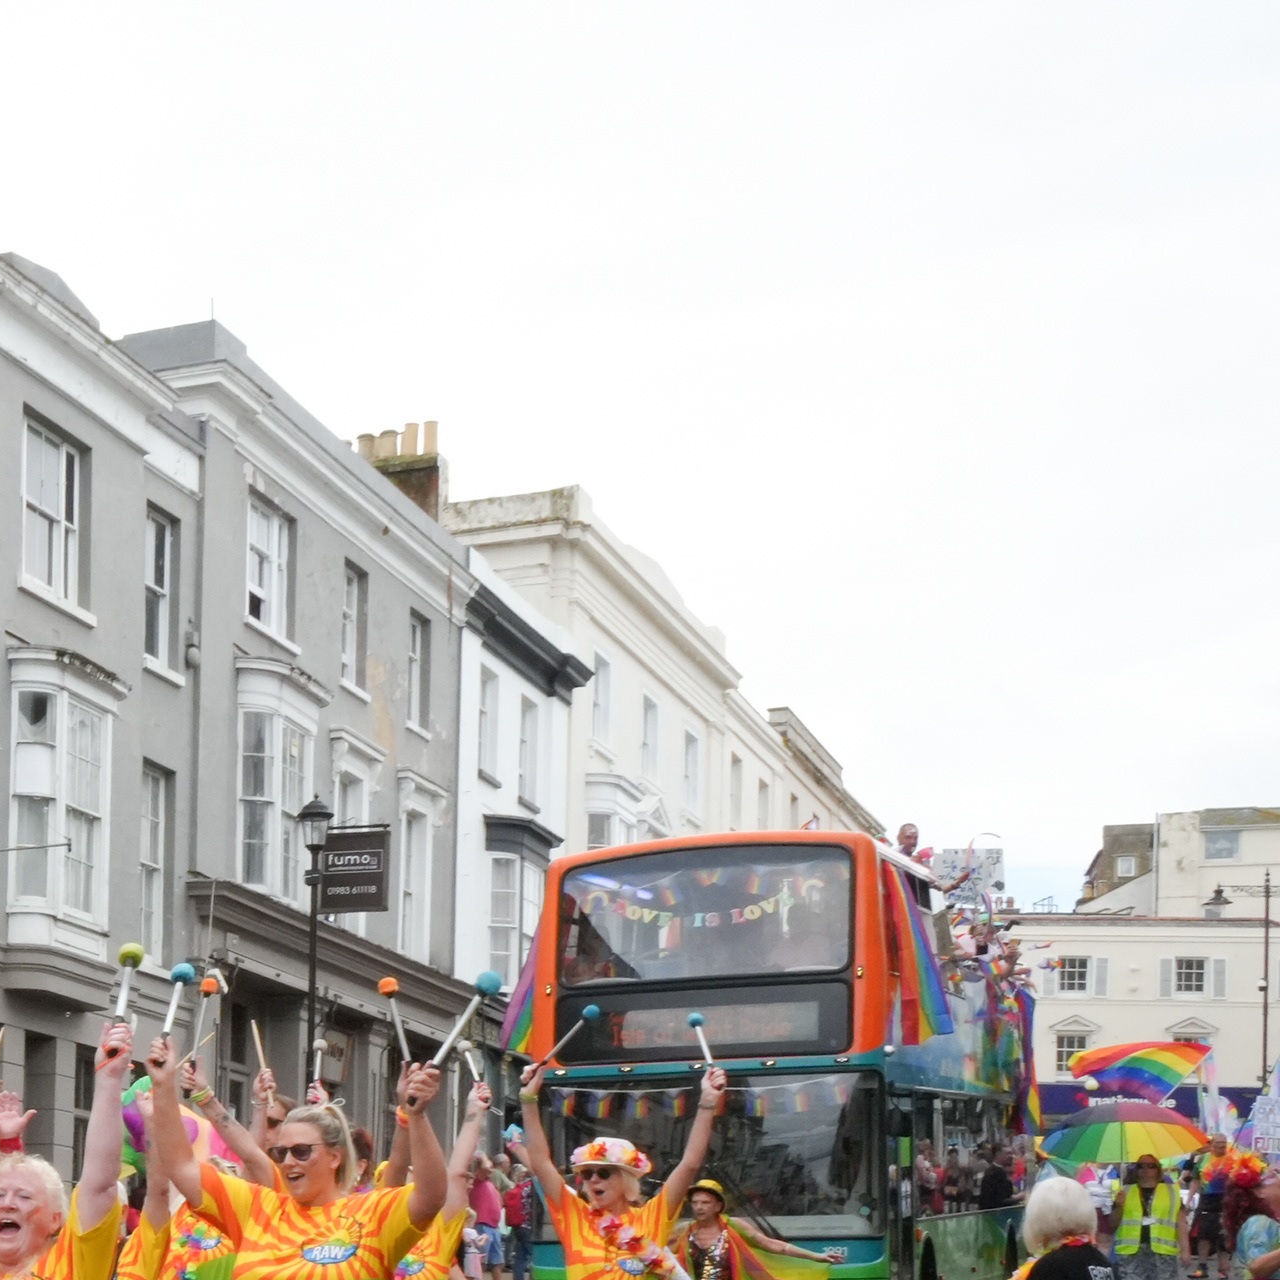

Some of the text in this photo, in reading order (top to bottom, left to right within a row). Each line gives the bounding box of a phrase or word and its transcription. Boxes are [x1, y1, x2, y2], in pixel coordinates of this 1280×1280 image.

[328, 854, 370, 866] fumo
[326, 886, 351, 896] 01983
[311, 1245, 346, 1261] RAW
